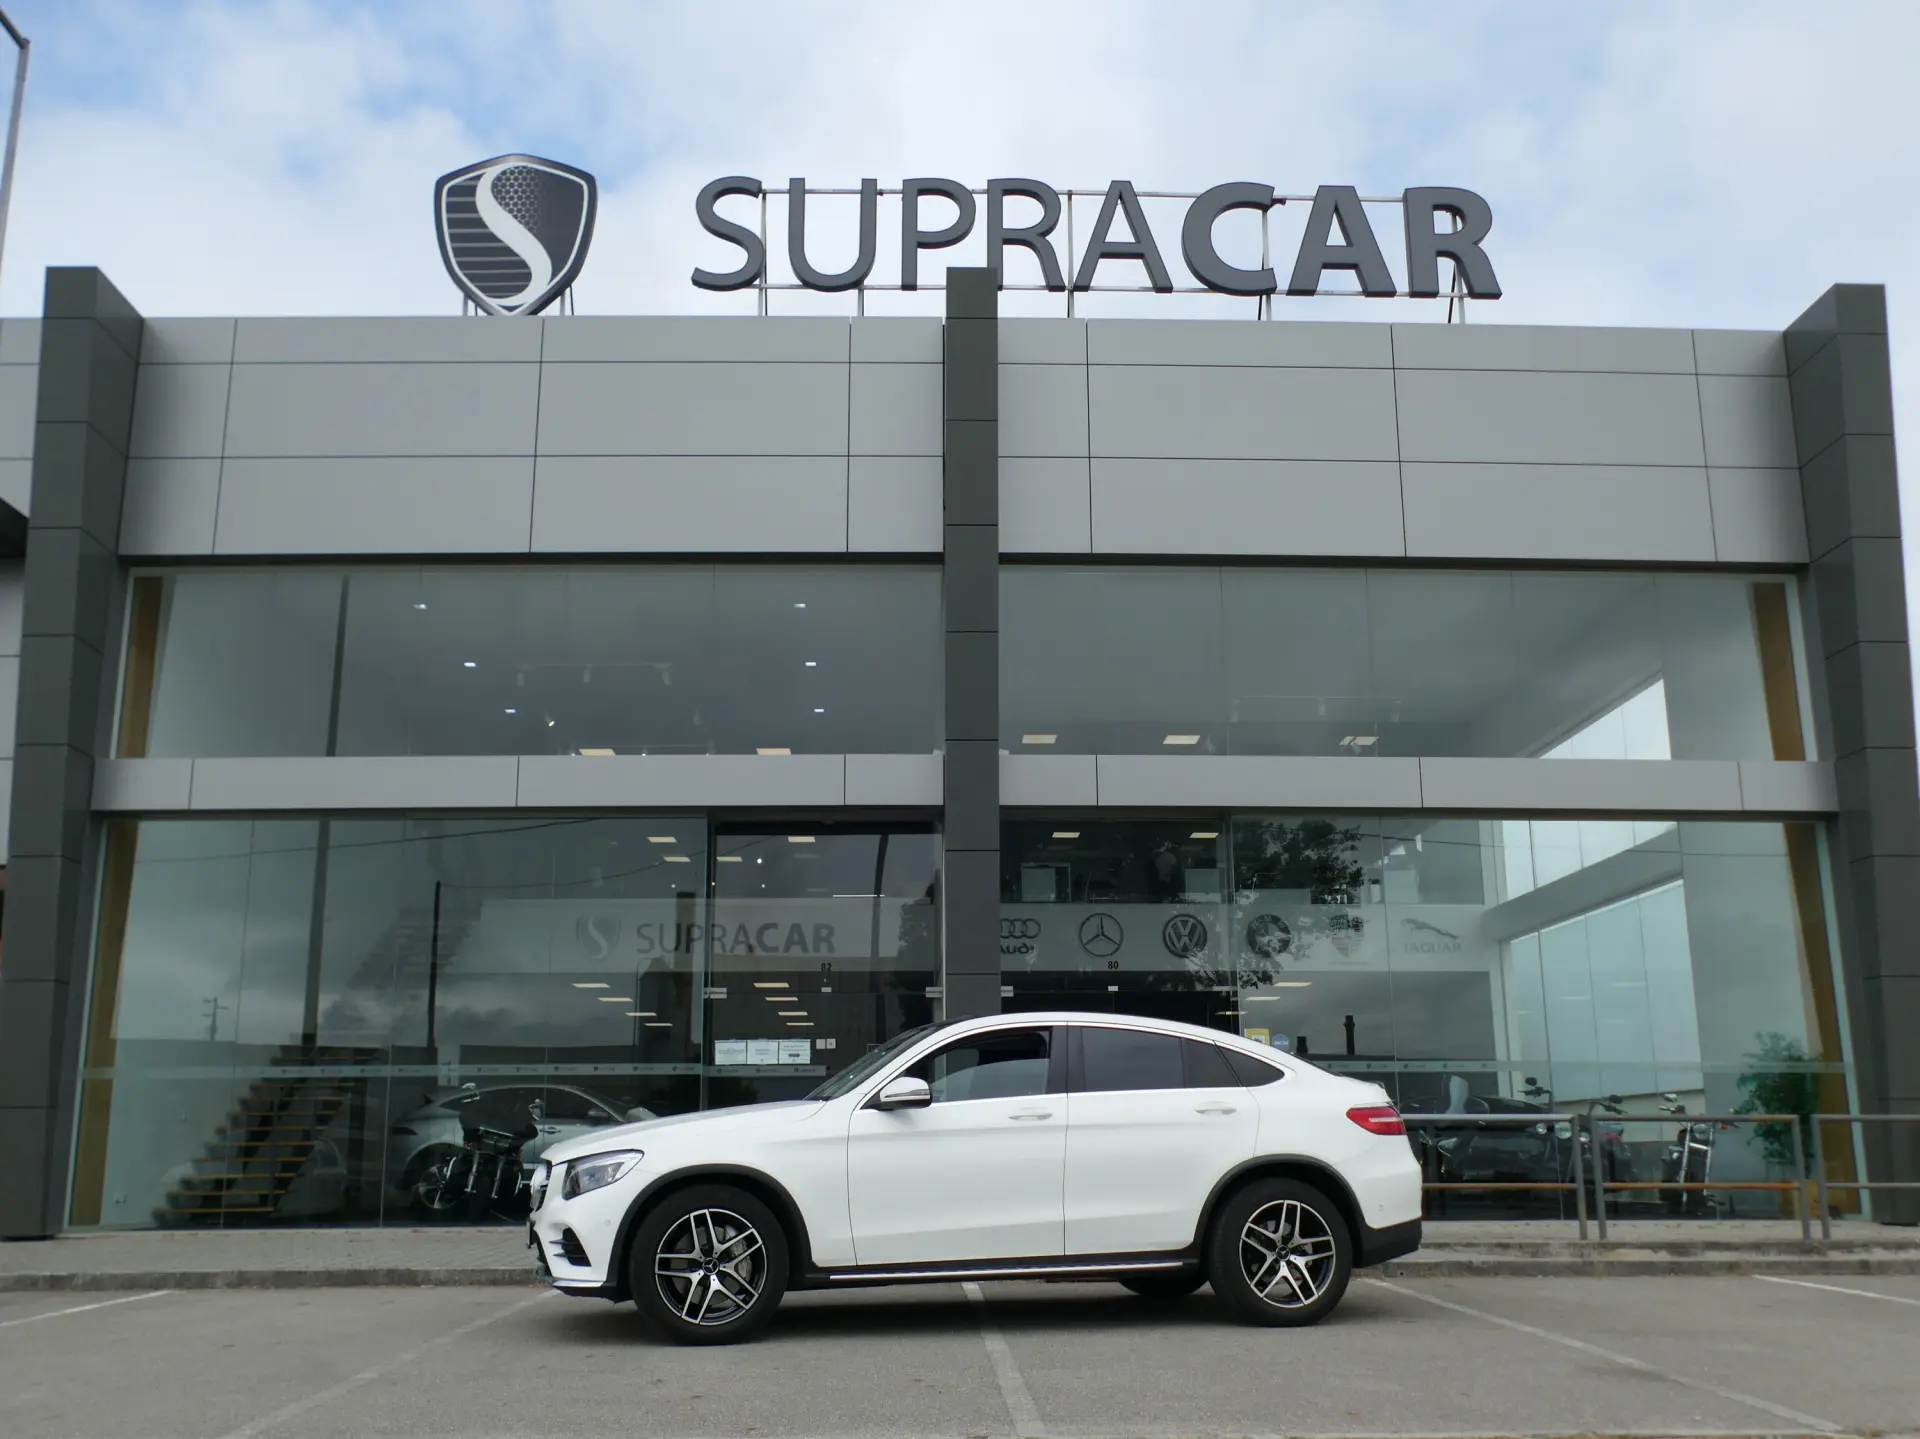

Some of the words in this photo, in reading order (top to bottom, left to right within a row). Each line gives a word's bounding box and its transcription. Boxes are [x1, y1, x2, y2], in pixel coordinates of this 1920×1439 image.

[691, 176, 1502, 299] SUPRACAR
[636, 922, 835, 954] SUPRACAR
[1404, 942, 1462, 953] JAGUAR
[820, 962, 832, 972] 82
[1107, 960, 1119, 970] 80
